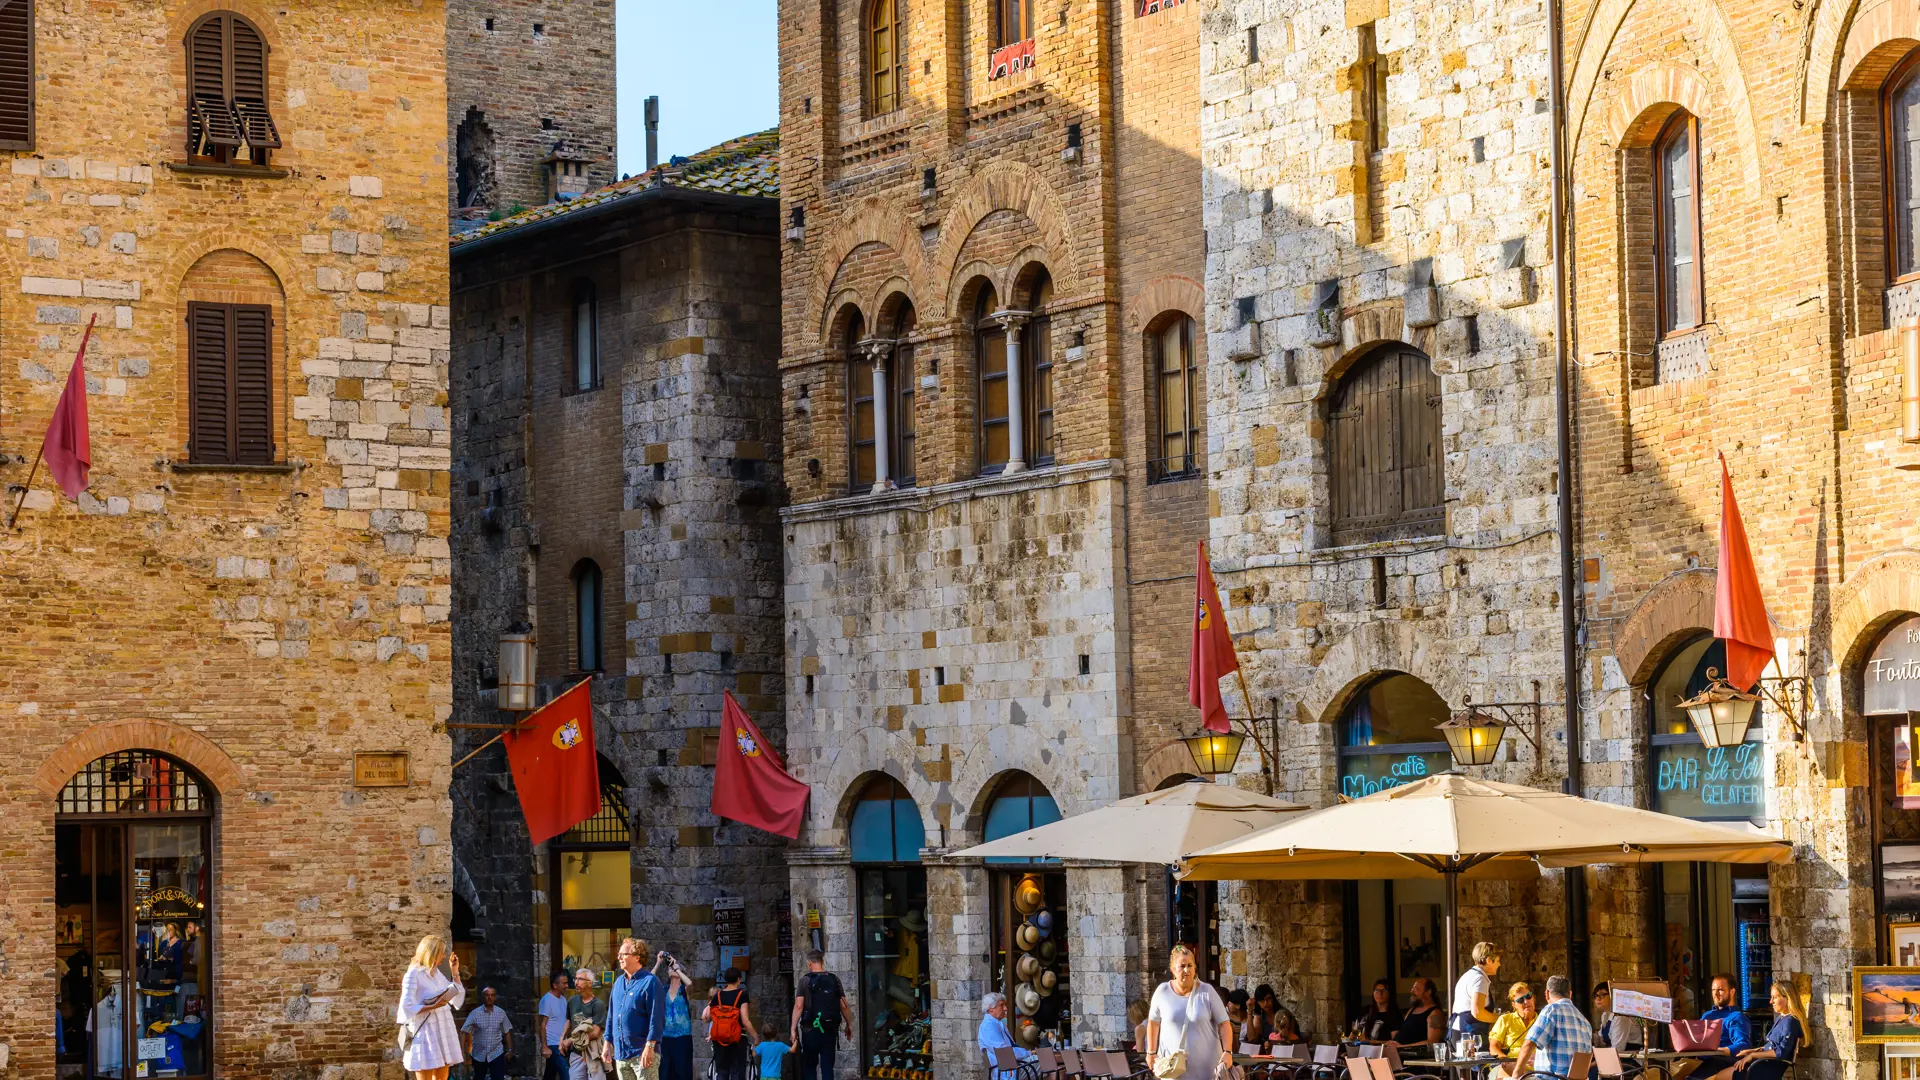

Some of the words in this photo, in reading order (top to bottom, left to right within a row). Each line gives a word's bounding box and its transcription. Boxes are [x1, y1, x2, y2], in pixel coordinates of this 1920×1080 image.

[370, 760, 392, 768] PIAZZA
[378, 770, 398, 778] DUOMO
[1391, 756, 1426, 776] caffè
[1658, 757, 1698, 790] BAR
[1702, 784, 1765, 804] GELATERI
